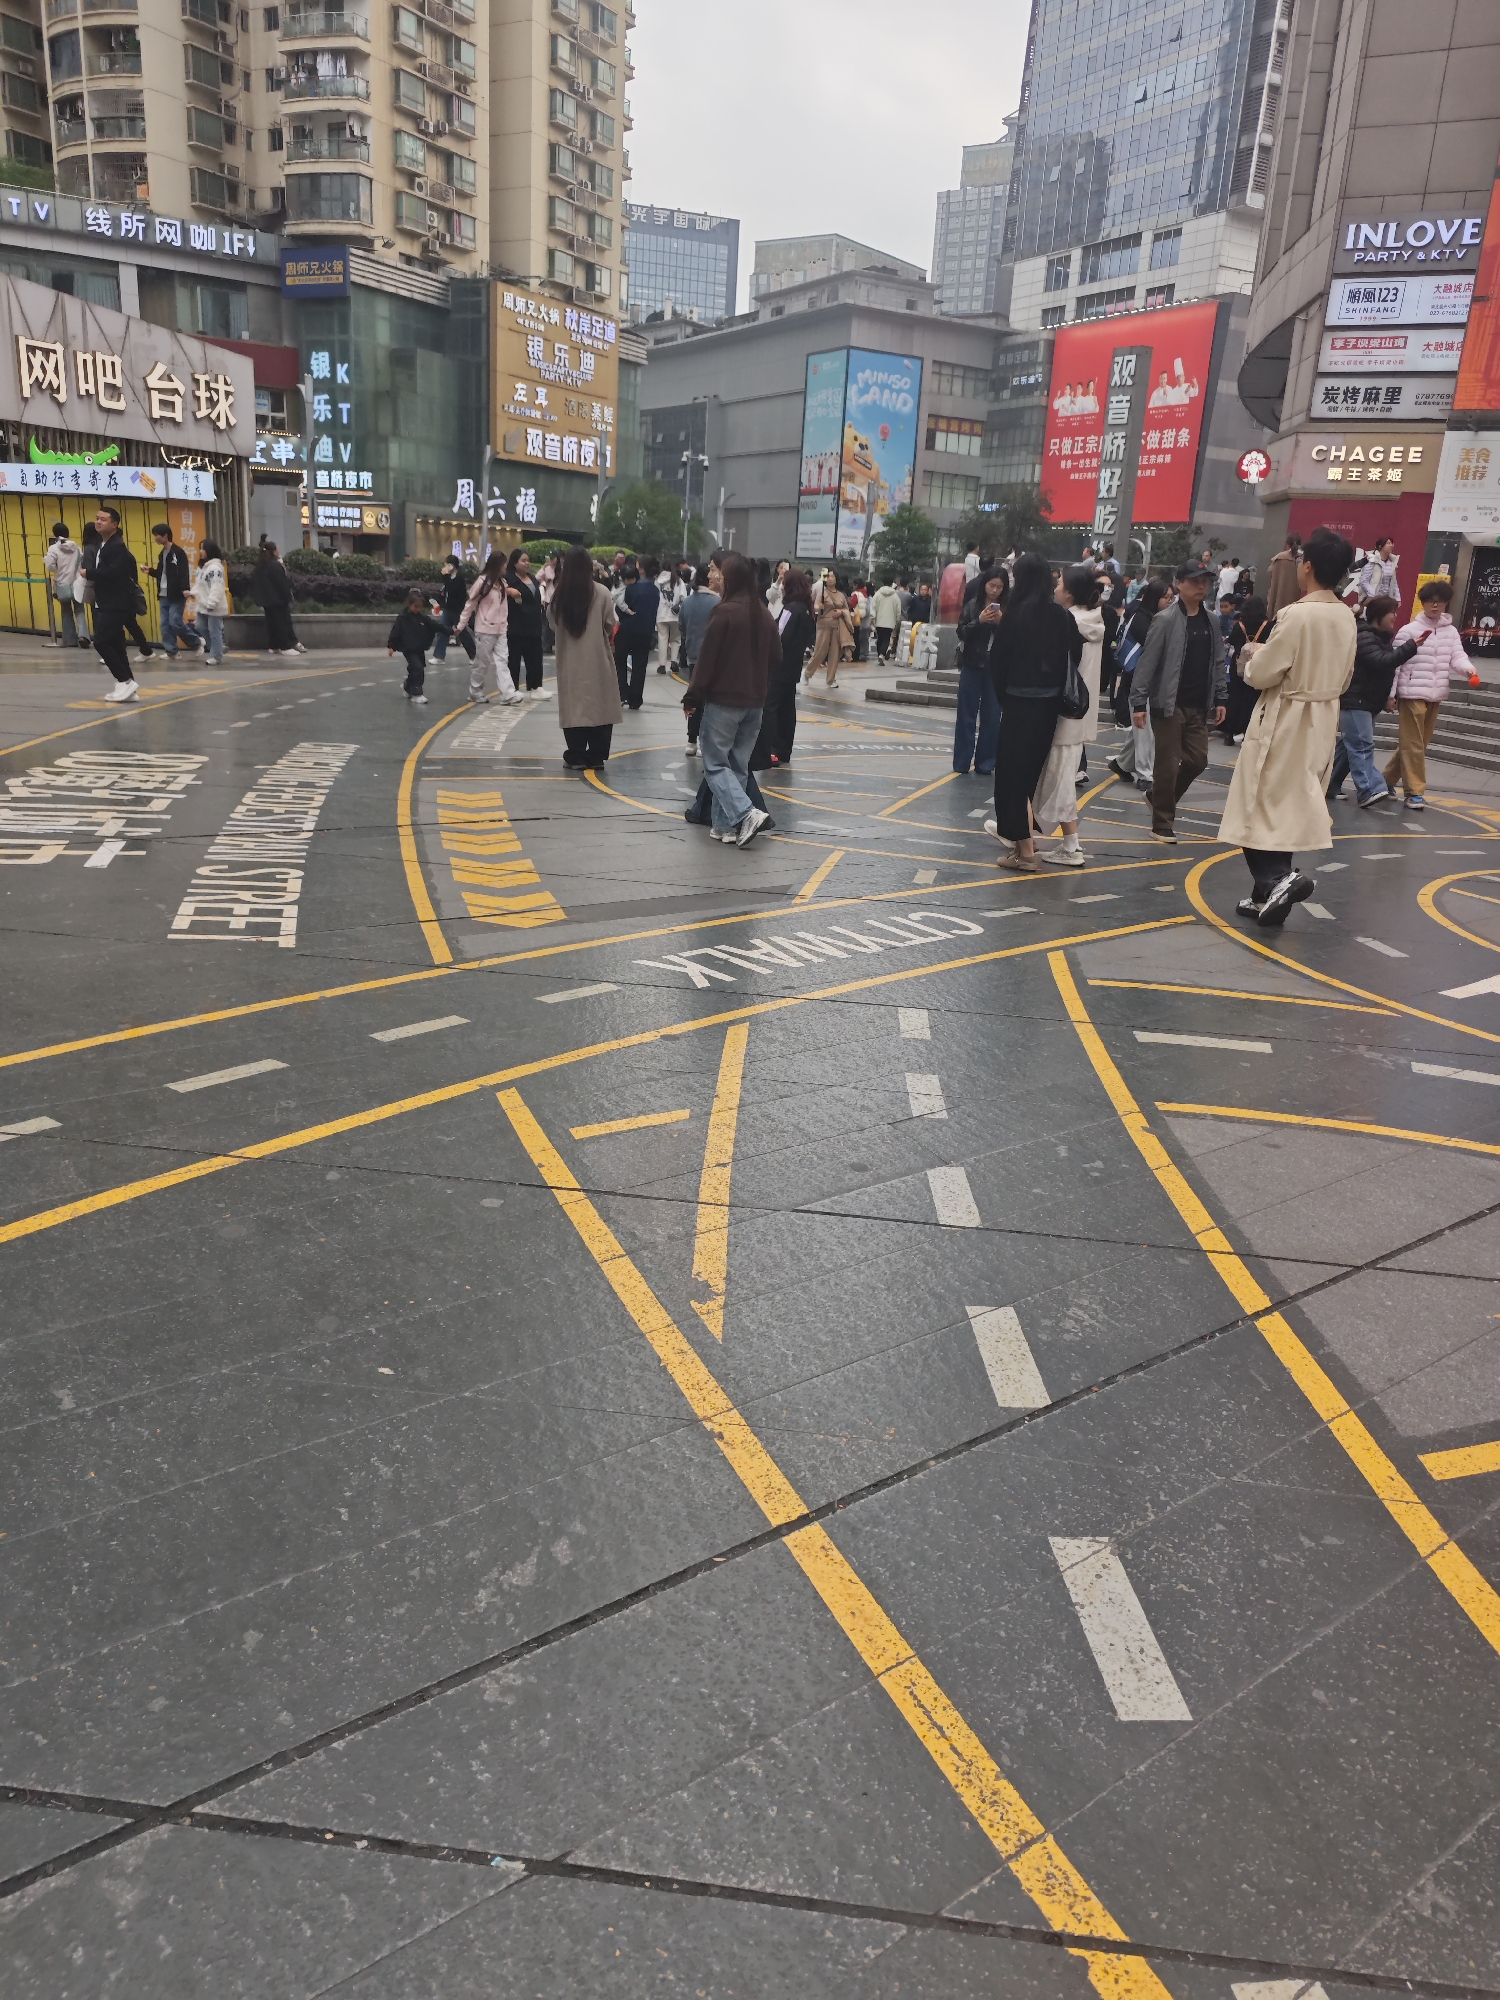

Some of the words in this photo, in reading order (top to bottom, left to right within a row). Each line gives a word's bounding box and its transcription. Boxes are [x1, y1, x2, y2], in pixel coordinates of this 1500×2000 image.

[1344, 218, 1482, 250] INLOVE
[286, 260, 343, 275] 周师兄火锅
[1354, 251, 1412, 263] PARTY
[1417, 250, 1426, 260] &
[1430, 249, 1467, 260] KTV
[1433, 283, 1473, 294] 大融城店
[503, 291, 560, 326] 周师兄火锅
[1345, 306, 1396, 314] SHINFANG
[564, 307, 616, 344] 秋岸足道
[527, 335, 594, 375] 银乐迪
[1333, 338, 1405, 348] 李子坝梁山鸡
[16, 335, 127, 411] 网吧
[145, 362, 237, 430] 台球
[857, 369, 911, 390] MINISO
[513, 381, 548, 408] 左耳
[851, 384, 914, 414] LAND
[1321, 386, 1403, 405] 炭烤麻里
[310, 351, 334, 463] 银乐迪
[1312, 446, 1423, 463] CHAGEE
[1459, 447, 1492, 464] 美食
[20, 469, 119, 491] 自助行李寄存
[1327, 468, 1403, 482] 霸王茶姬
[1455, 465, 1488, 481] 推荐
[452, 478, 538, 524] 周六福
[204, 786, 331, 863] PEDESTRIAN
[166, 865, 305, 948] STREET
[632, 911, 985, 989] CITYWALK
